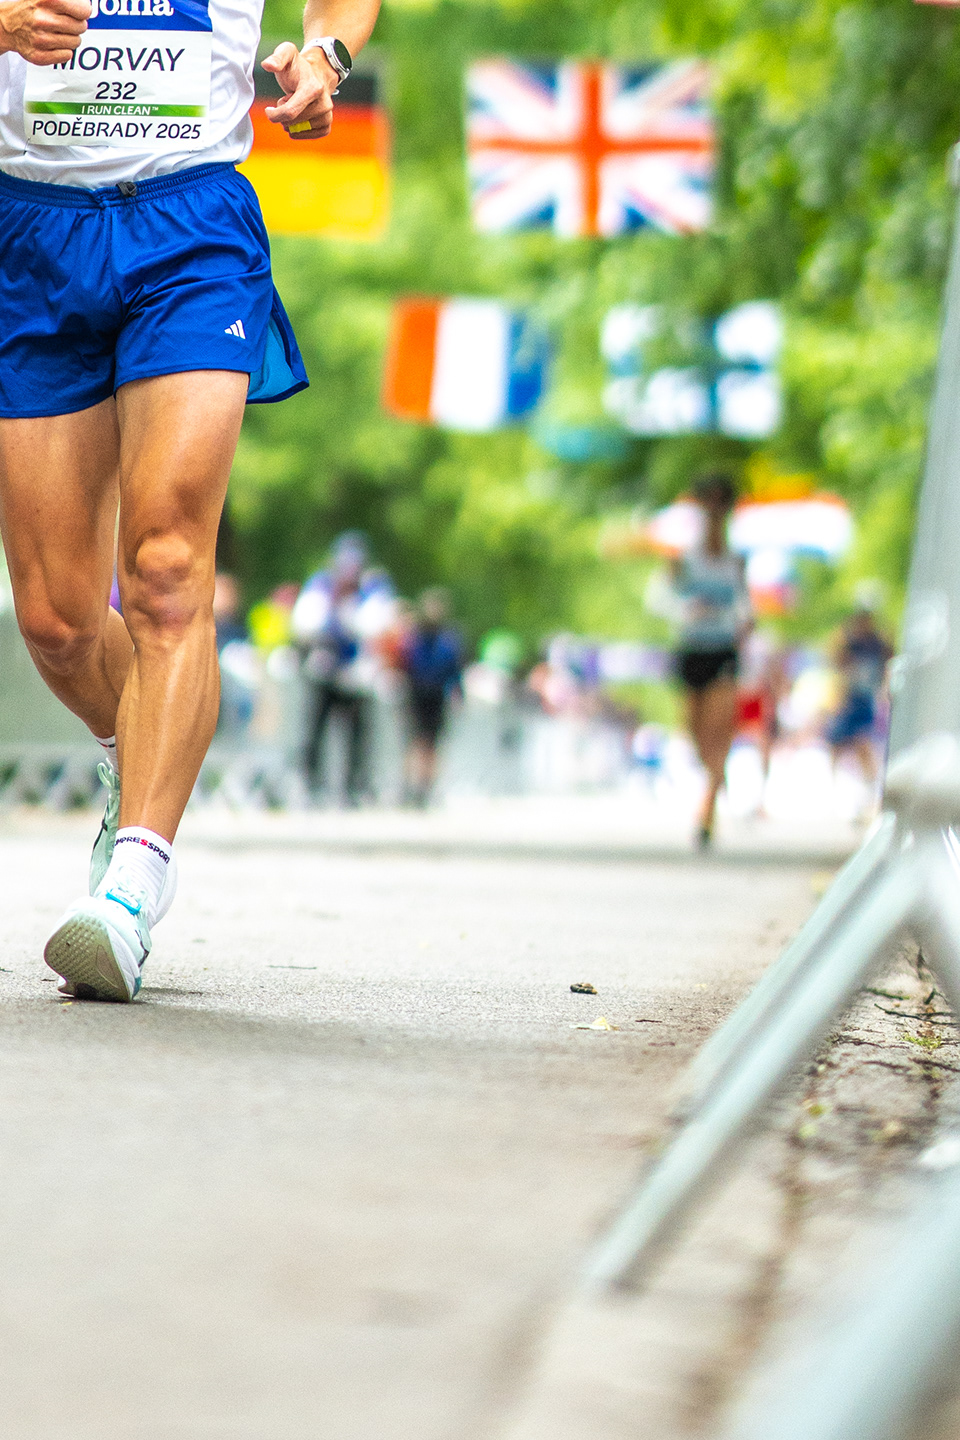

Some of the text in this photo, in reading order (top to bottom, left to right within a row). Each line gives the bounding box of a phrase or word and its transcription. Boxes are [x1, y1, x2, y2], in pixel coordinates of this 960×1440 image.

[95, 81, 137, 100] 232
[81, 105, 86, 114] I
[87, 105, 112, 115] RUN
[32, 117, 202, 140] PODĚBRADY 2025
